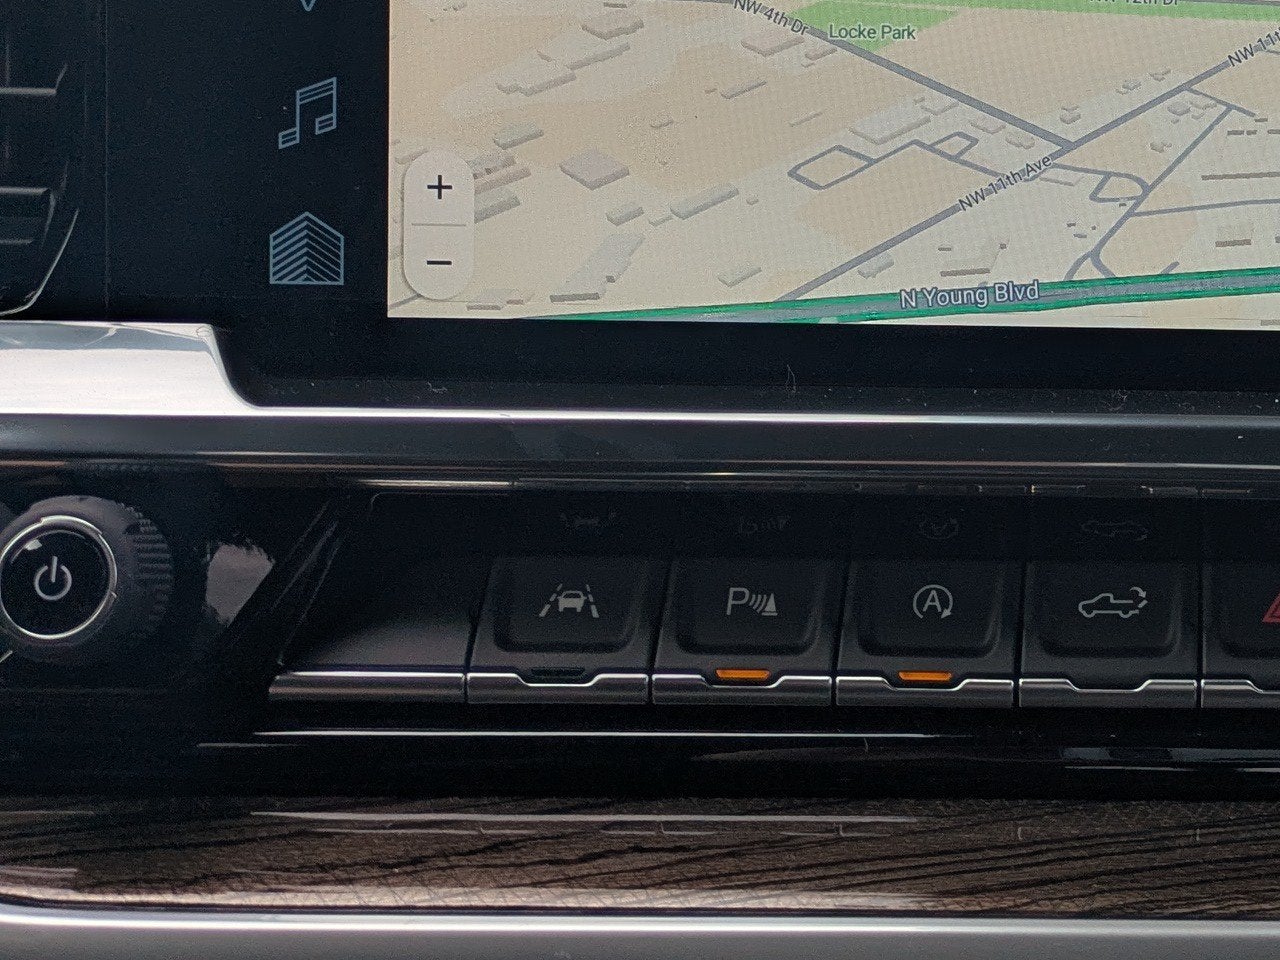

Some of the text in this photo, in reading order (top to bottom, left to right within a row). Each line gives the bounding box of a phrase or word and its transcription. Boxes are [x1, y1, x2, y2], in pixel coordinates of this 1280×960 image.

[762, 5, 788, 27] 4th
[788, 16, 809, 36] Dr
[828, 22, 916, 41] Locke Park
[1227, 43, 1255, 68] NW
[957, 153, 1053, 212] NW 11th Ave
[900, 280, 1040, 309] N Young Blvd
